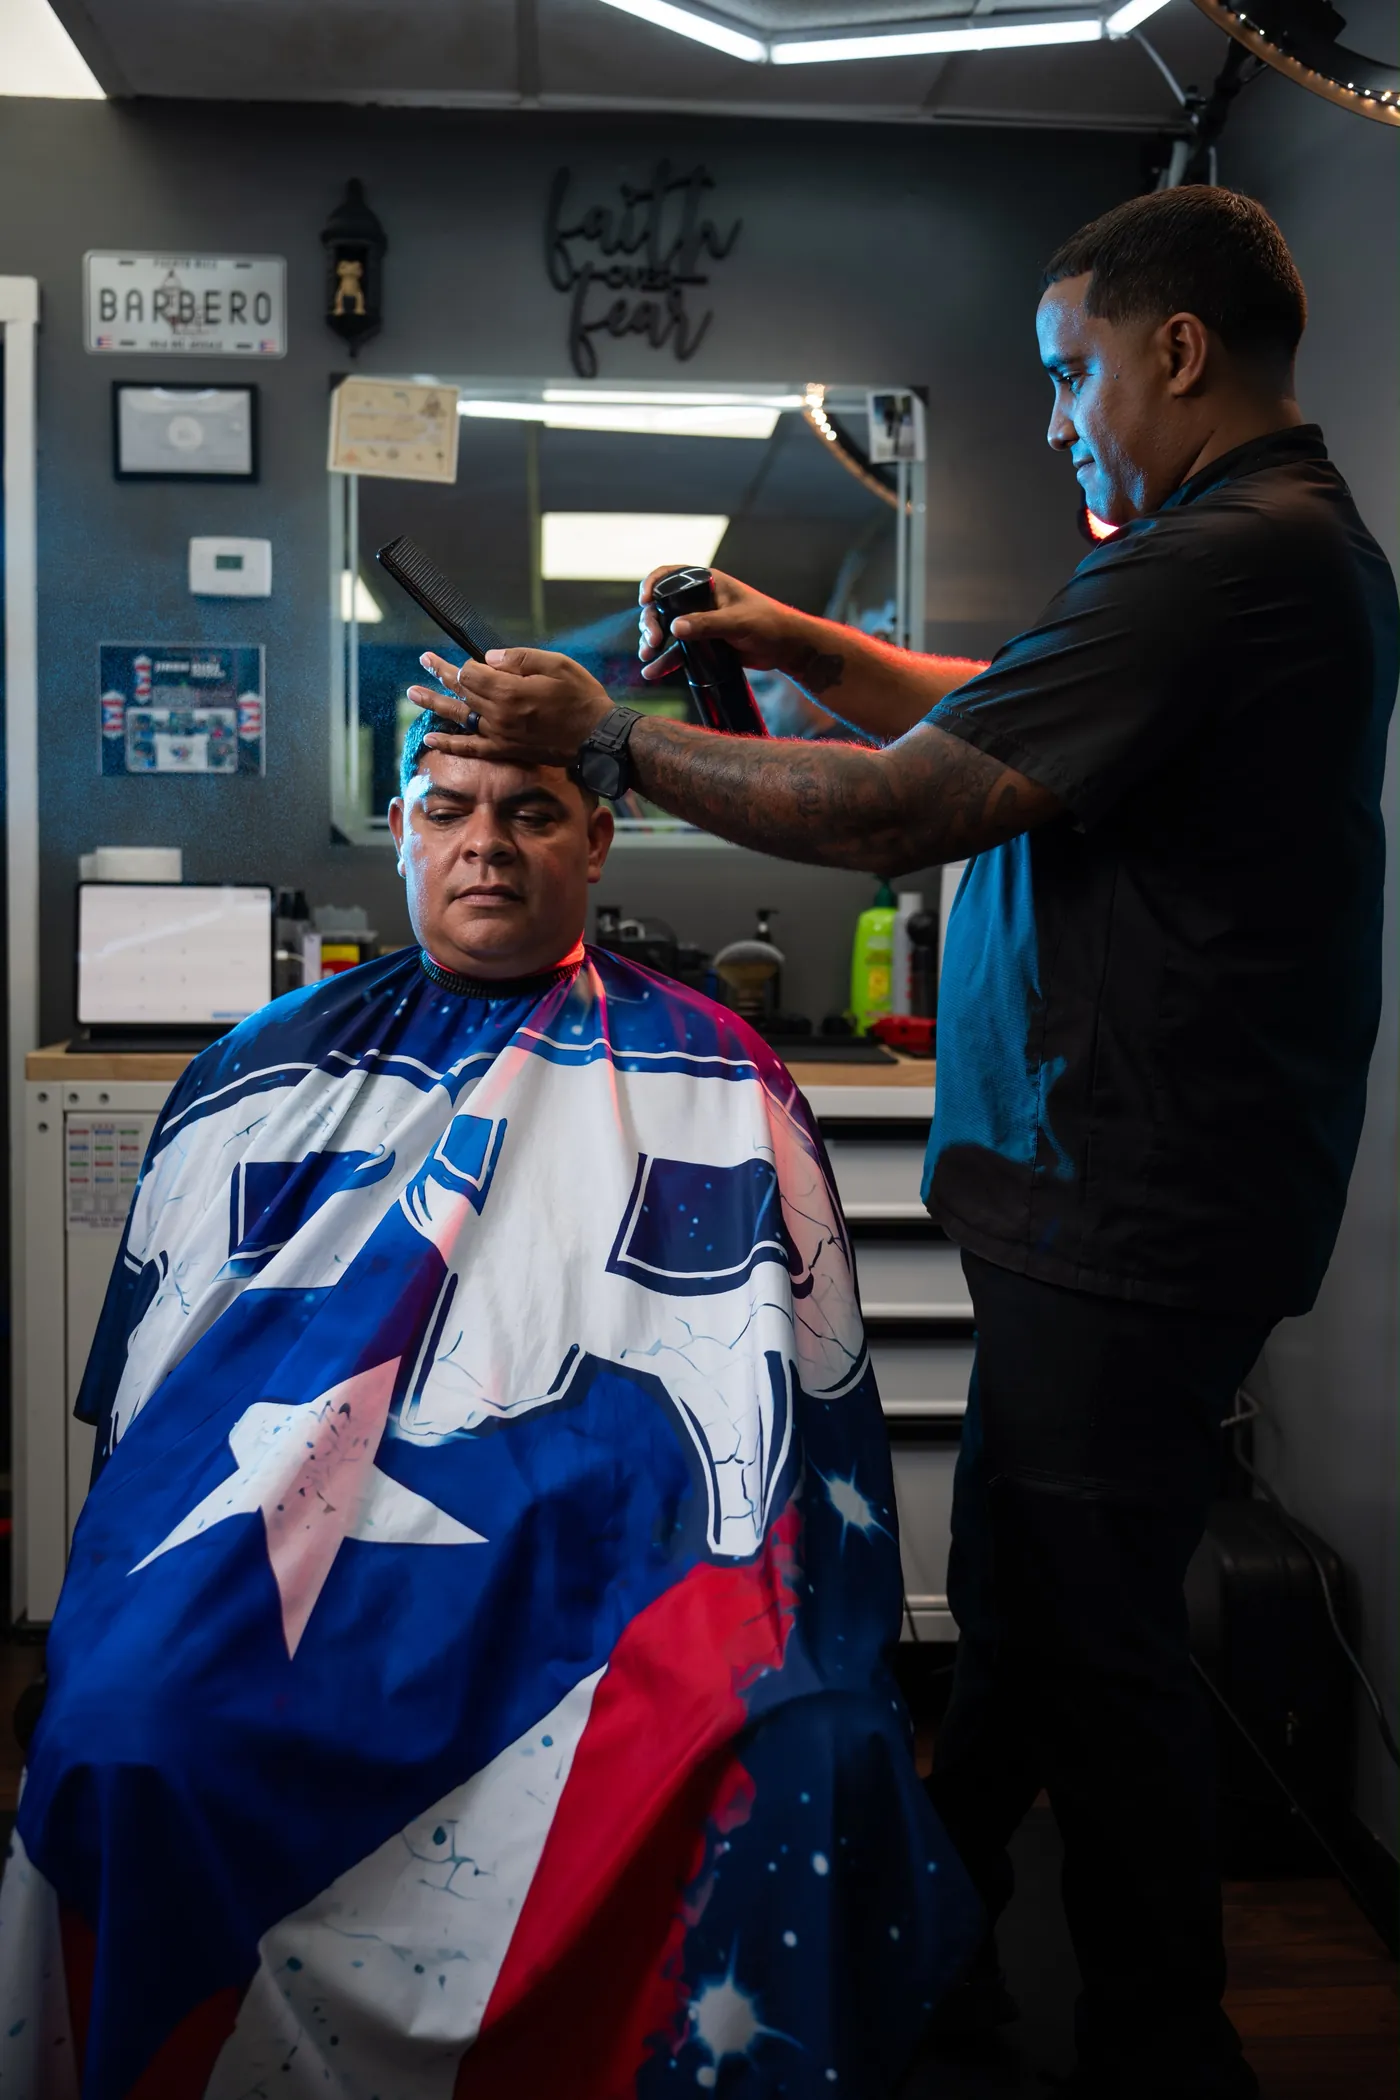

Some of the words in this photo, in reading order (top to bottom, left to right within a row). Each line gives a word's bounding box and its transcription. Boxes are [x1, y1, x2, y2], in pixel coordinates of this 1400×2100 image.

[543, 157, 743, 293] faith
[99, 287, 272, 326] BARBERO
[569, 261, 714, 380] fear
